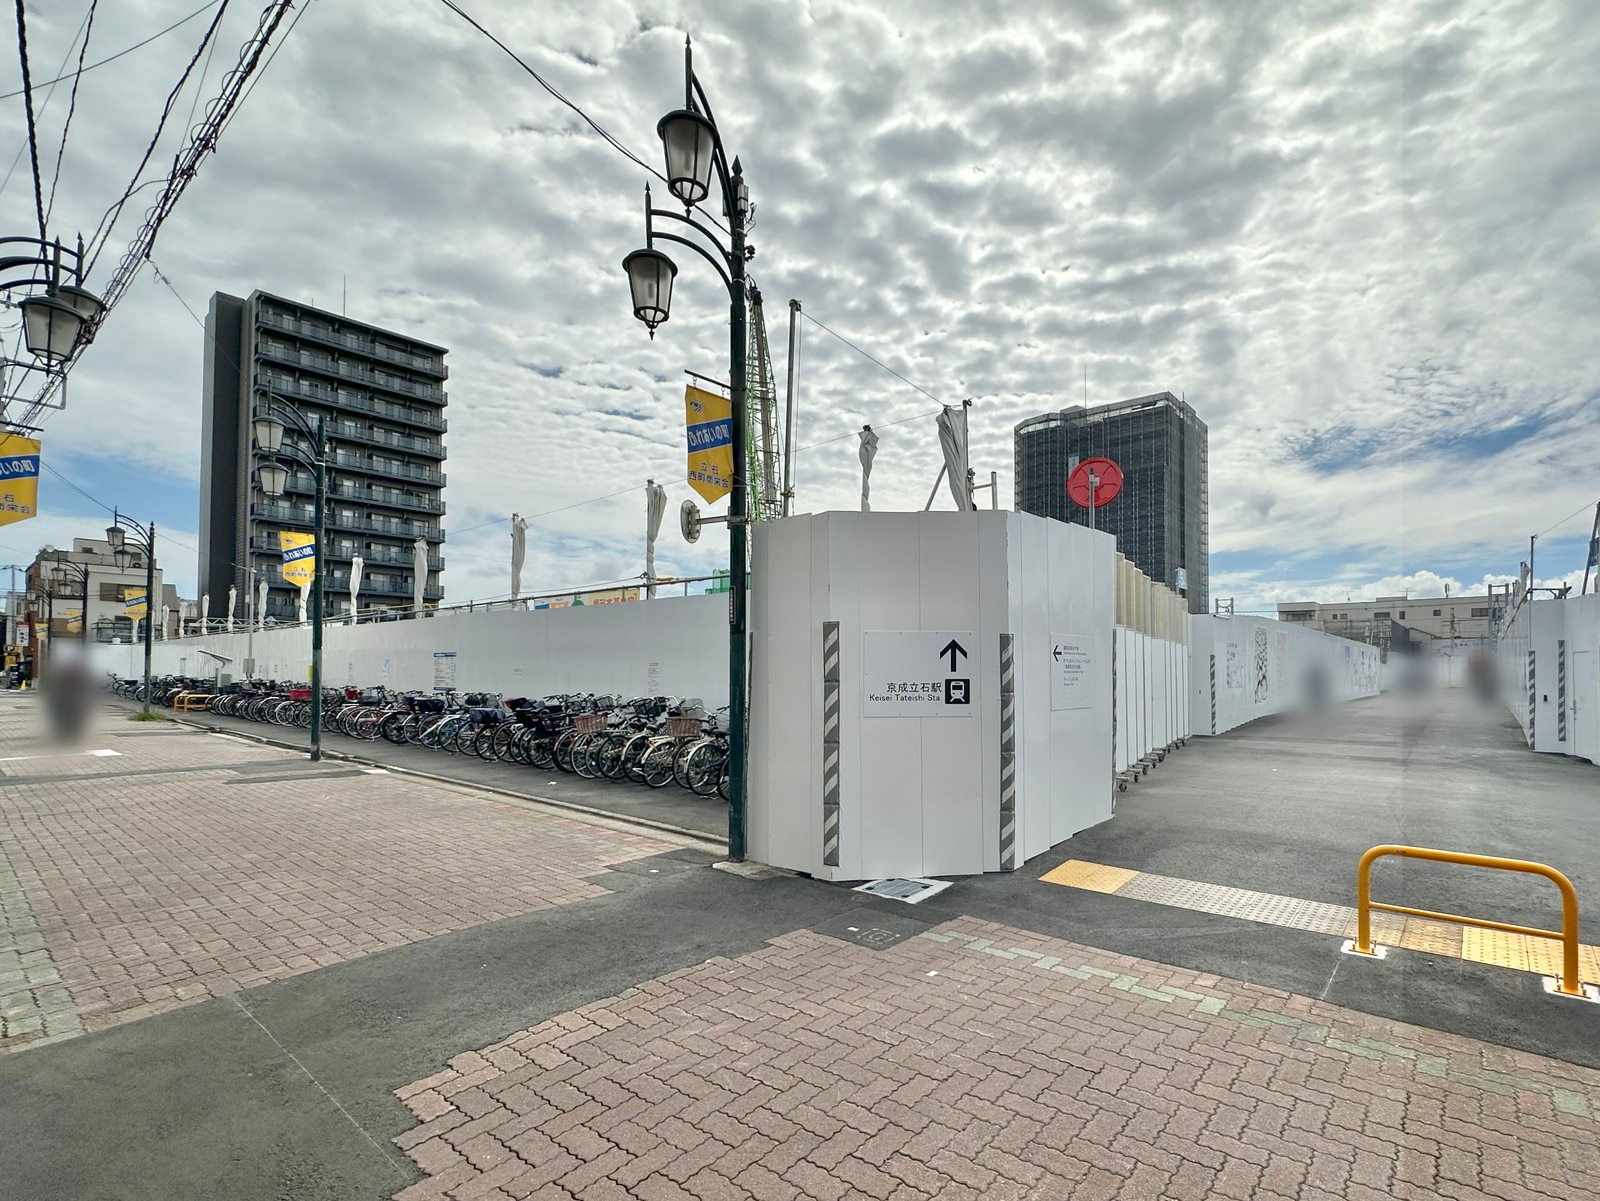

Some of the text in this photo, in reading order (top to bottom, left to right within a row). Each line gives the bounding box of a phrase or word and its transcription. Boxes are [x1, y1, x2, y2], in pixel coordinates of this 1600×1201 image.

[886, 682, 942, 693] 京成立石駅
[869, 694, 893, 702] Keisei
[895, 694, 925, 702] Tateishi
